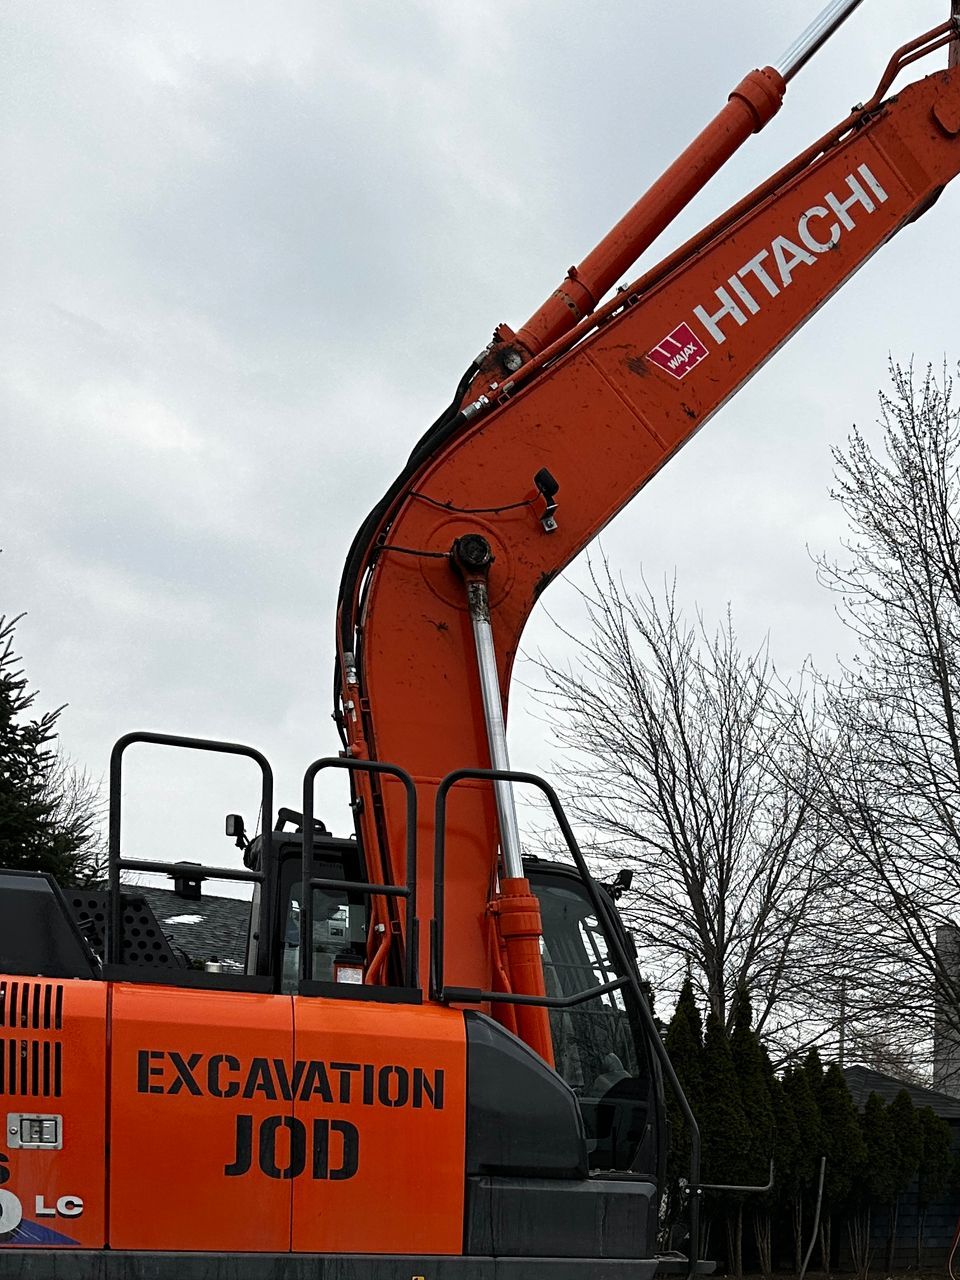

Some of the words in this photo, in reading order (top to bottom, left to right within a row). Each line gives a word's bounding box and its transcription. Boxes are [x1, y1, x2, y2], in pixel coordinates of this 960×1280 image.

[693, 163, 889, 345] HITACHI
[667, 341, 698, 370] WAJAX
[137, 1049, 444, 1110] EXCAVATION
[224, 1114, 360, 1181] JOD
[35, 1195, 84, 1217] LC
